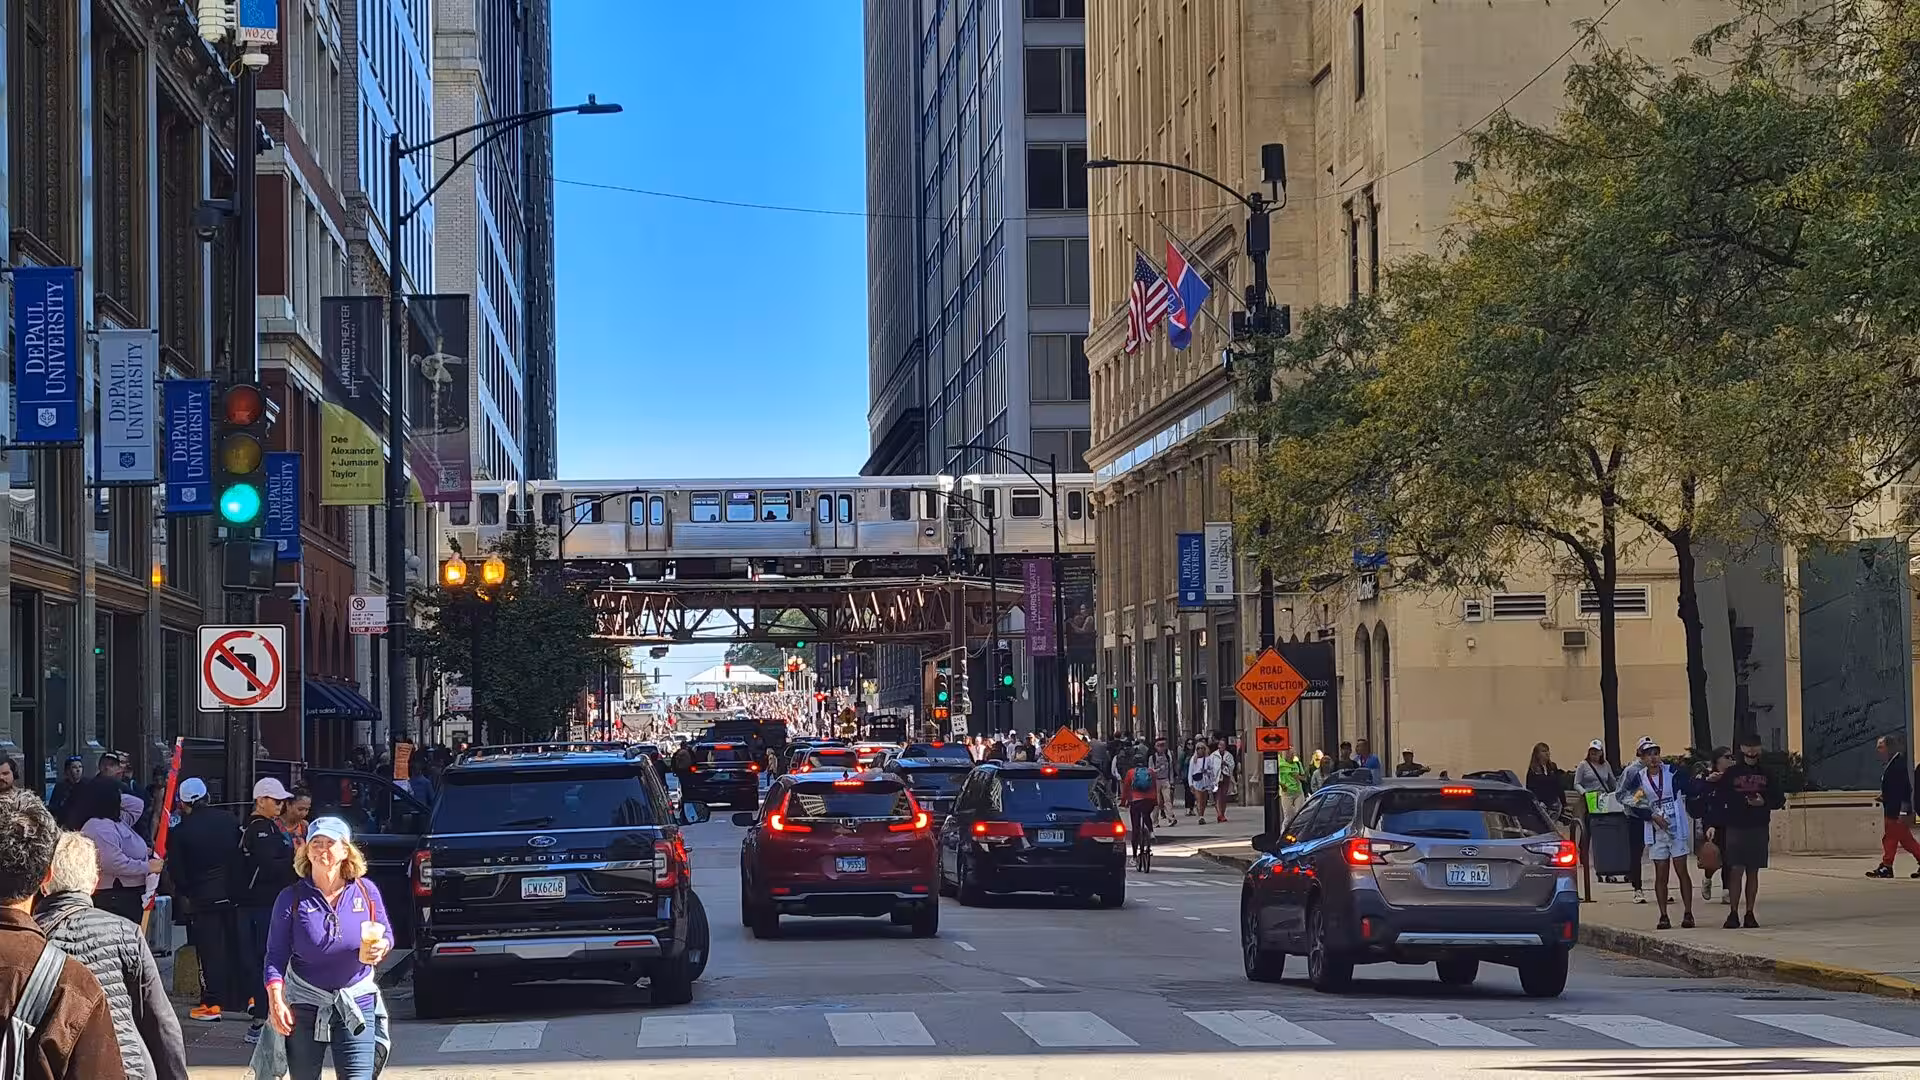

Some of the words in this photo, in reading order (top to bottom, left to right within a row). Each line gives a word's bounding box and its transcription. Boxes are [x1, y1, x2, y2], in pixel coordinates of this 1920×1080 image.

[25, 301, 45, 374] DEPAUL
[46, 281, 66, 396] UNIVERSITY
[109, 360, 126, 423] DEPAUL
[127, 342, 144, 440] UNIVERSITY
[172, 405, 187, 463] DEPAUL
[187, 390, 202, 479] UNIVERSITY
[331, 435, 348, 443] Dee
[331, 447, 375, 455] Alexander
[268, 473, 280, 519] DEPAUL
[280, 460, 293, 532] UNIVERSITY
[331, 470, 357, 479] Taylor
[1190, 538, 1200, 588] UNIVERSITY
[1240, 681, 1304, 691] CONSTRUCTION
[1260, 665, 1283, 675] ROAD
[1258, 696, 1287, 706] AHEAD
[483, 853, 601, 863] EXPEDITION
[1450, 870, 1466, 881] 772
